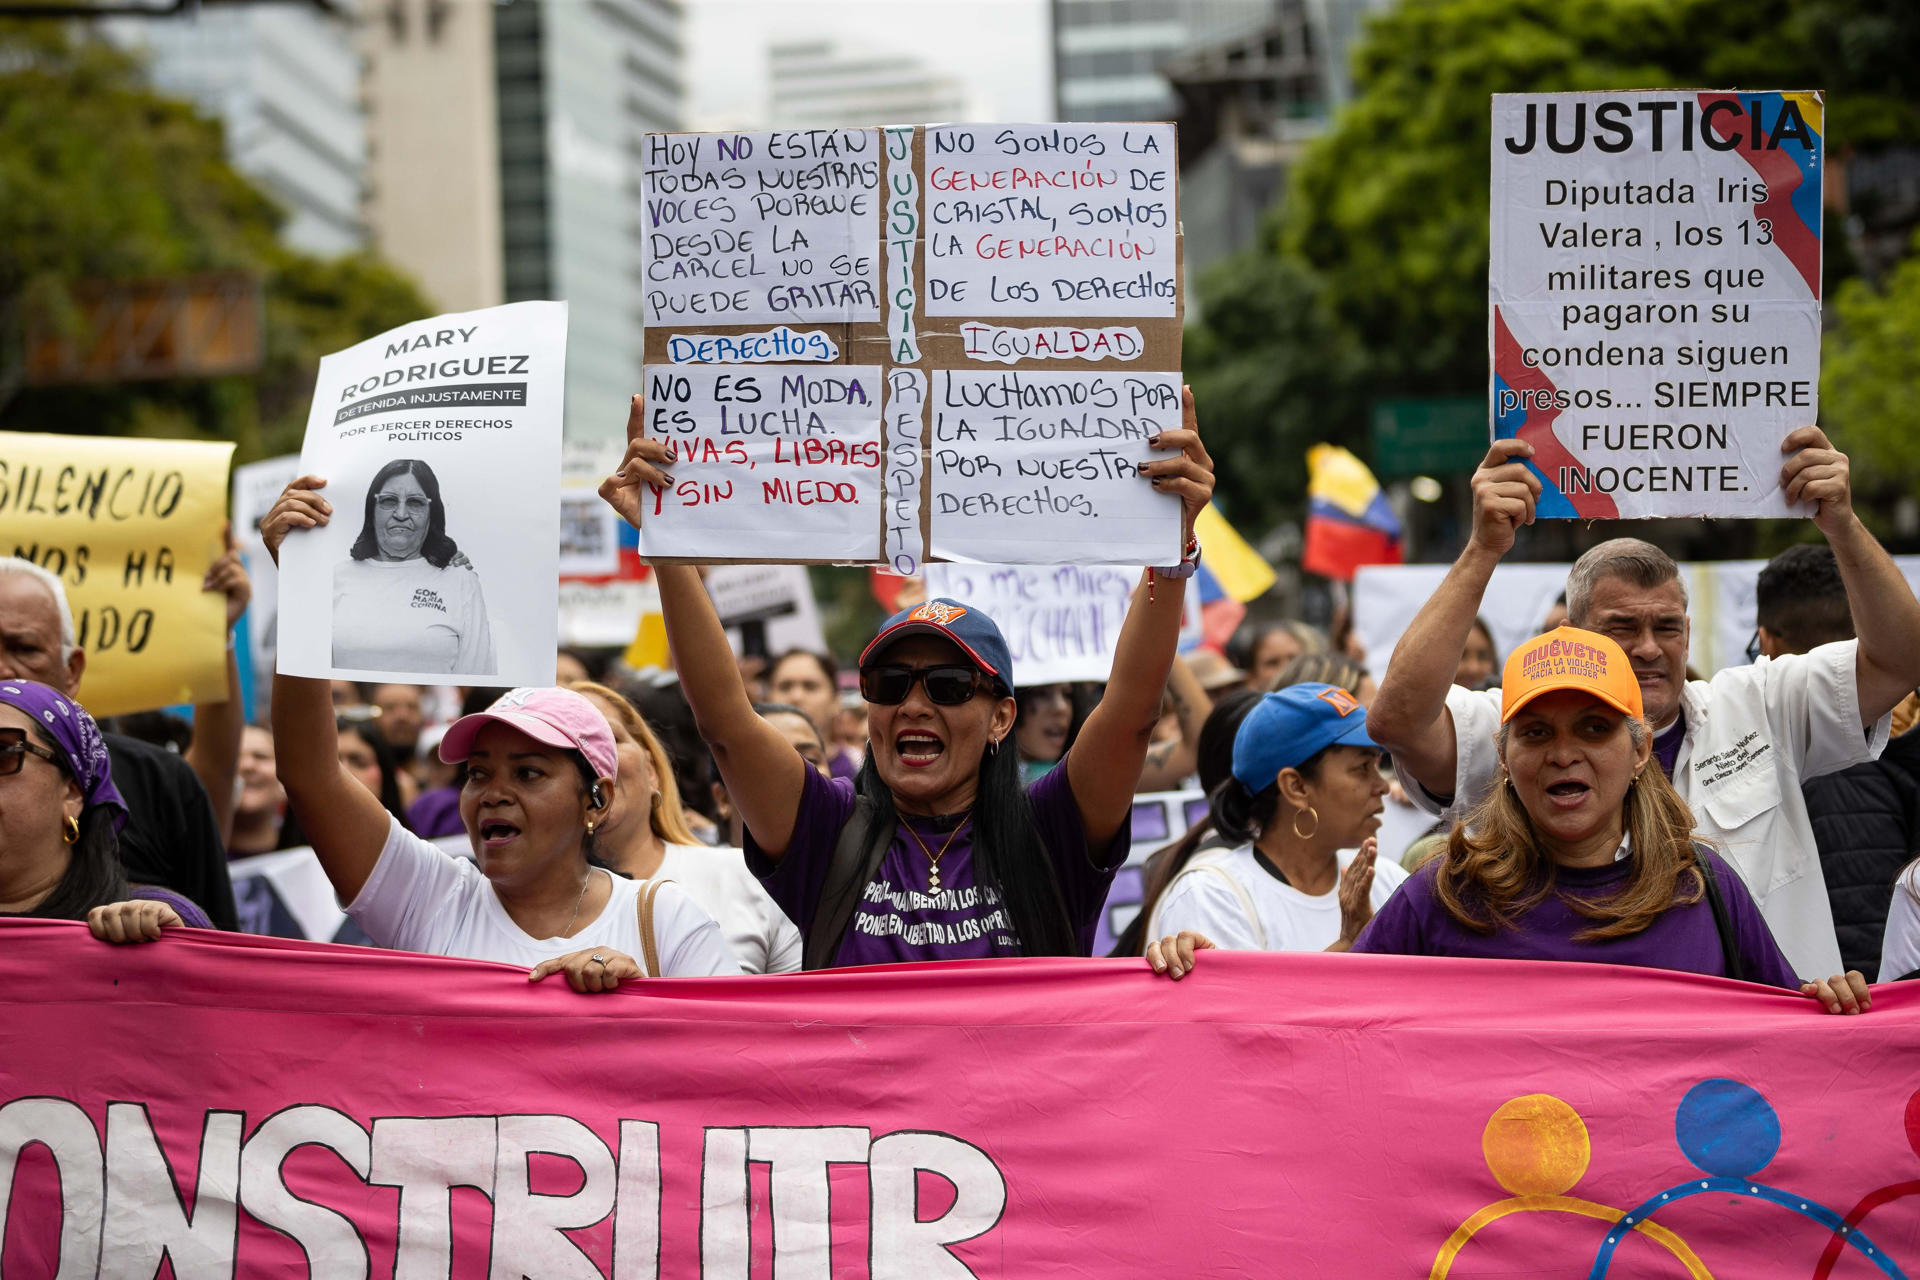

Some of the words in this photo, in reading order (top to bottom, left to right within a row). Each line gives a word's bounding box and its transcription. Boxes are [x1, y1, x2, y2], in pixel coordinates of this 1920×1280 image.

[935, 132, 975, 154] NO
[995, 129, 1106, 156] SOMOS
[1123, 132, 1160, 154] LA
[1505, 100, 1815, 154] JUSTICIA
[717, 135, 753, 161] NO
[768, 129, 867, 159] ESTÁN
[645, 168, 746, 193] TODAS
[758, 161, 879, 191] NUESTRAS
[931, 160, 1118, 191] GENERACIÓN
[1130, 168, 1166, 192] DE
[648, 197, 736, 227] VOCES
[750, 192, 868, 220] PORQUE
[1546, 178, 1694, 212] Diputada
[1718, 177, 1769, 204] Iris
[933, 196, 1057, 232] CRISTAL,
[1069, 198, 1168, 228] SOMOS
[650, 229, 753, 260] DESDE
[773, 225, 808, 253] LA
[933, 232, 963, 257] LA
[976, 229, 1156, 261] GENERACIÓN
[1540, 221, 1642, 248] Valera
[1675, 220, 1723, 246] los
[1737, 219, 1774, 245] 13
[648, 254, 765, 282] CARCEL
[782, 258, 813, 277] NO
[830, 255, 870, 276] SE
[1549, 264, 1691, 290] militares
[1704, 267, 1765, 294] que
[648, 290, 750, 321] PUEDE
[767, 280, 880, 312] GRITAR.
[929, 279, 968, 302] DE
[991, 275, 1039, 302] LOS
[1563, 303, 1698, 330] pagaron
[1711, 303, 1750, 323] su
[385, 326, 479, 360] MARY
[670, 328, 838, 362] DERECHOS.
[965, 327, 1142, 357] IGUALDAD.
[1522, 341, 1664, 367] condena
[1677, 340, 1789, 372] siguen
[340, 355, 529, 403] RODRIGUEZ
[652, 374, 692, 402] NO
[714, 374, 762, 403] ES
[781, 374, 872, 408] MODA,
[338, 396, 406, 421] DETENIDA
[410, 389, 521, 405] INJUSTAMENTE
[1124, 379, 1179, 416] POR
[1500, 388, 1641, 417] presos...
[1654, 381, 1810, 408] SIEMPRE
[340, 427, 366, 440] POR
[370, 420, 431, 434] EJERCER
[435, 419, 513, 429] DERECHOS
[388, 431, 462, 441] POLÍTICOS
[653, 408, 696, 433] ES
[720, 405, 835, 436] LUCHA.
[937, 413, 976, 441] LA
[993, 413, 1163, 441] IGUALDAD
[774, 437, 880, 468] LIBRES
[1582, 424, 1727, 450] FUERON
[888, 371, 921, 575] RESPETO
[936, 449, 1001, 477] POR
[1017, 449, 1137, 480] NUESTR
[1560, 466, 1749, 494] INOCENTE.
[648, 480, 664, 515] Y
[676, 480, 733, 506] SIN
[762, 477, 860, 506] MIEDO.
[937, 486, 1098, 517] DERECHOS.
[124, 546, 175, 588] HA
[415, 588, 438, 597] CON
[888, 913, 904, 935] EN
[946, 924, 957, 944] A
[956, 918, 981, 942] LOS
